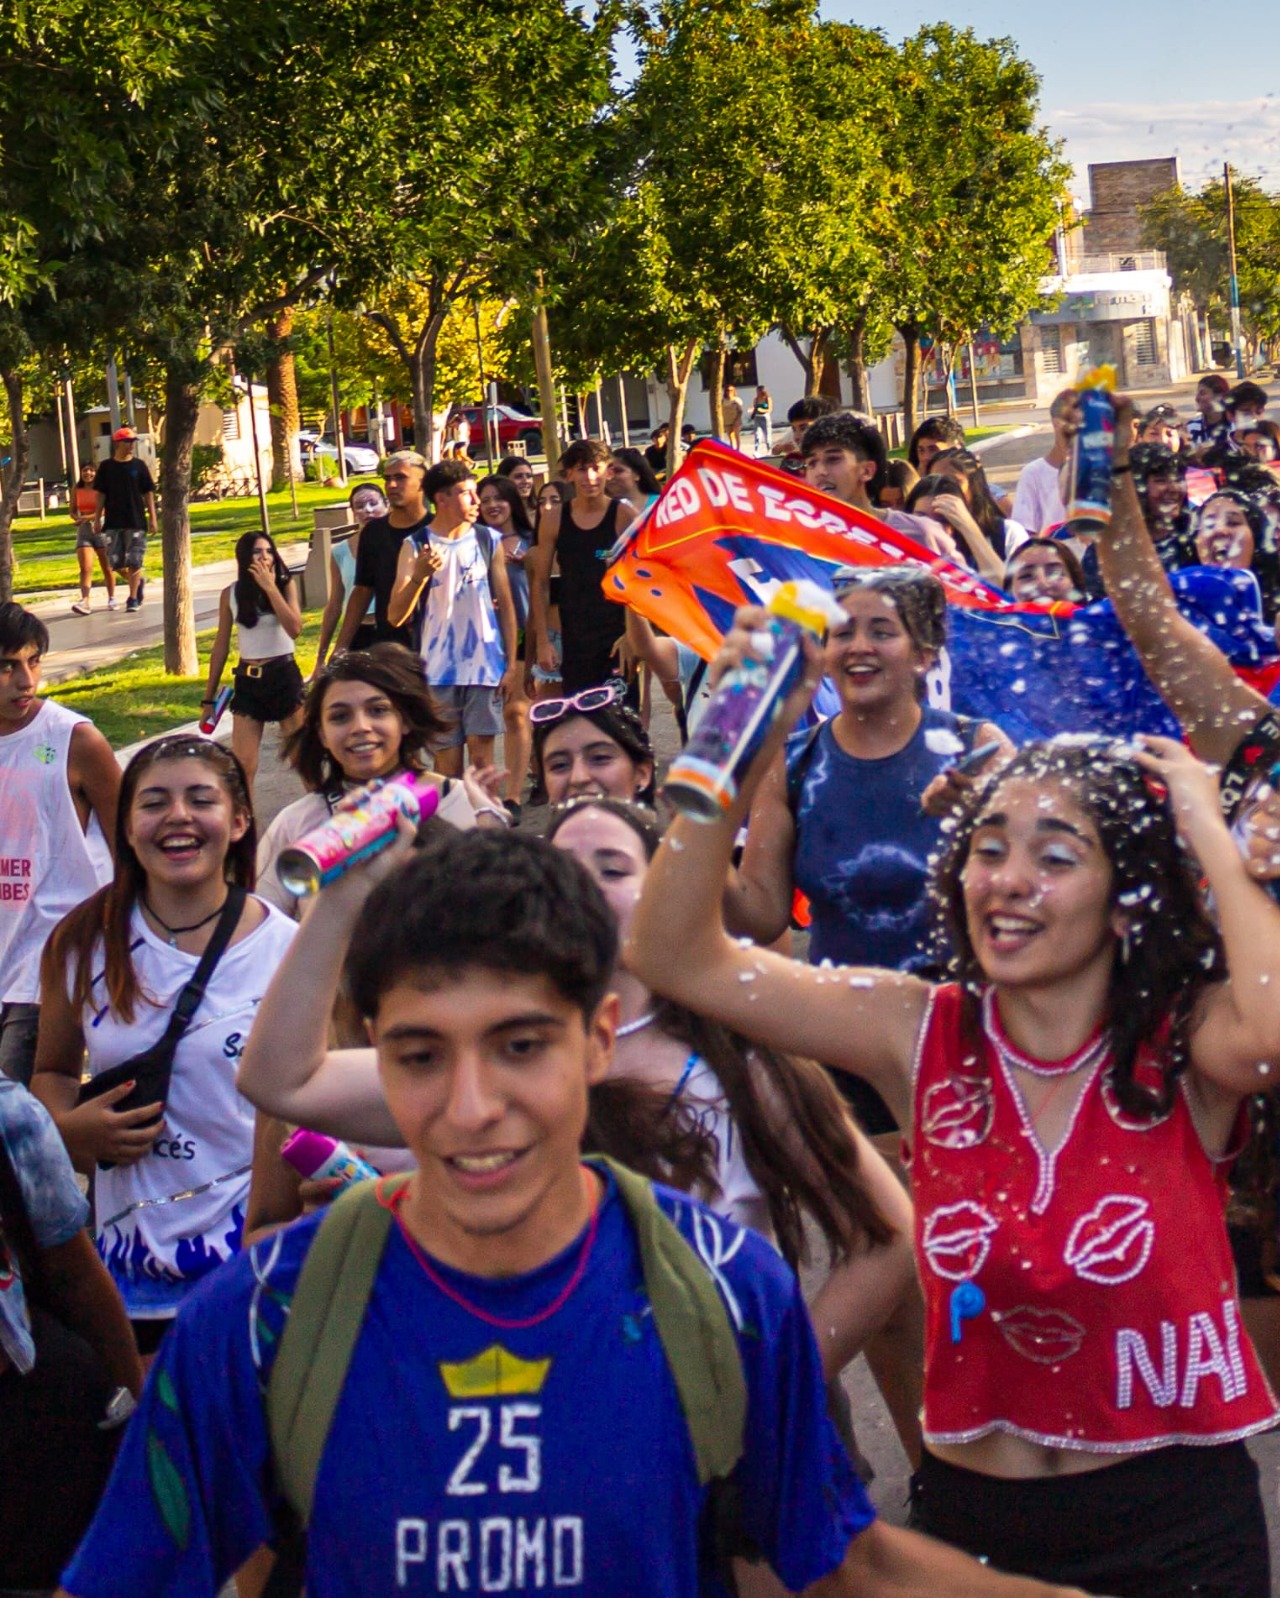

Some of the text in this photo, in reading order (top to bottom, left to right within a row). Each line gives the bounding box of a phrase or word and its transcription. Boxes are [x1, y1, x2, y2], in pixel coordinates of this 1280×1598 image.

[697, 467, 754, 513] DE
[446, 1403, 542, 1496] 25
[395, 1514, 584, 1592] PROMO
